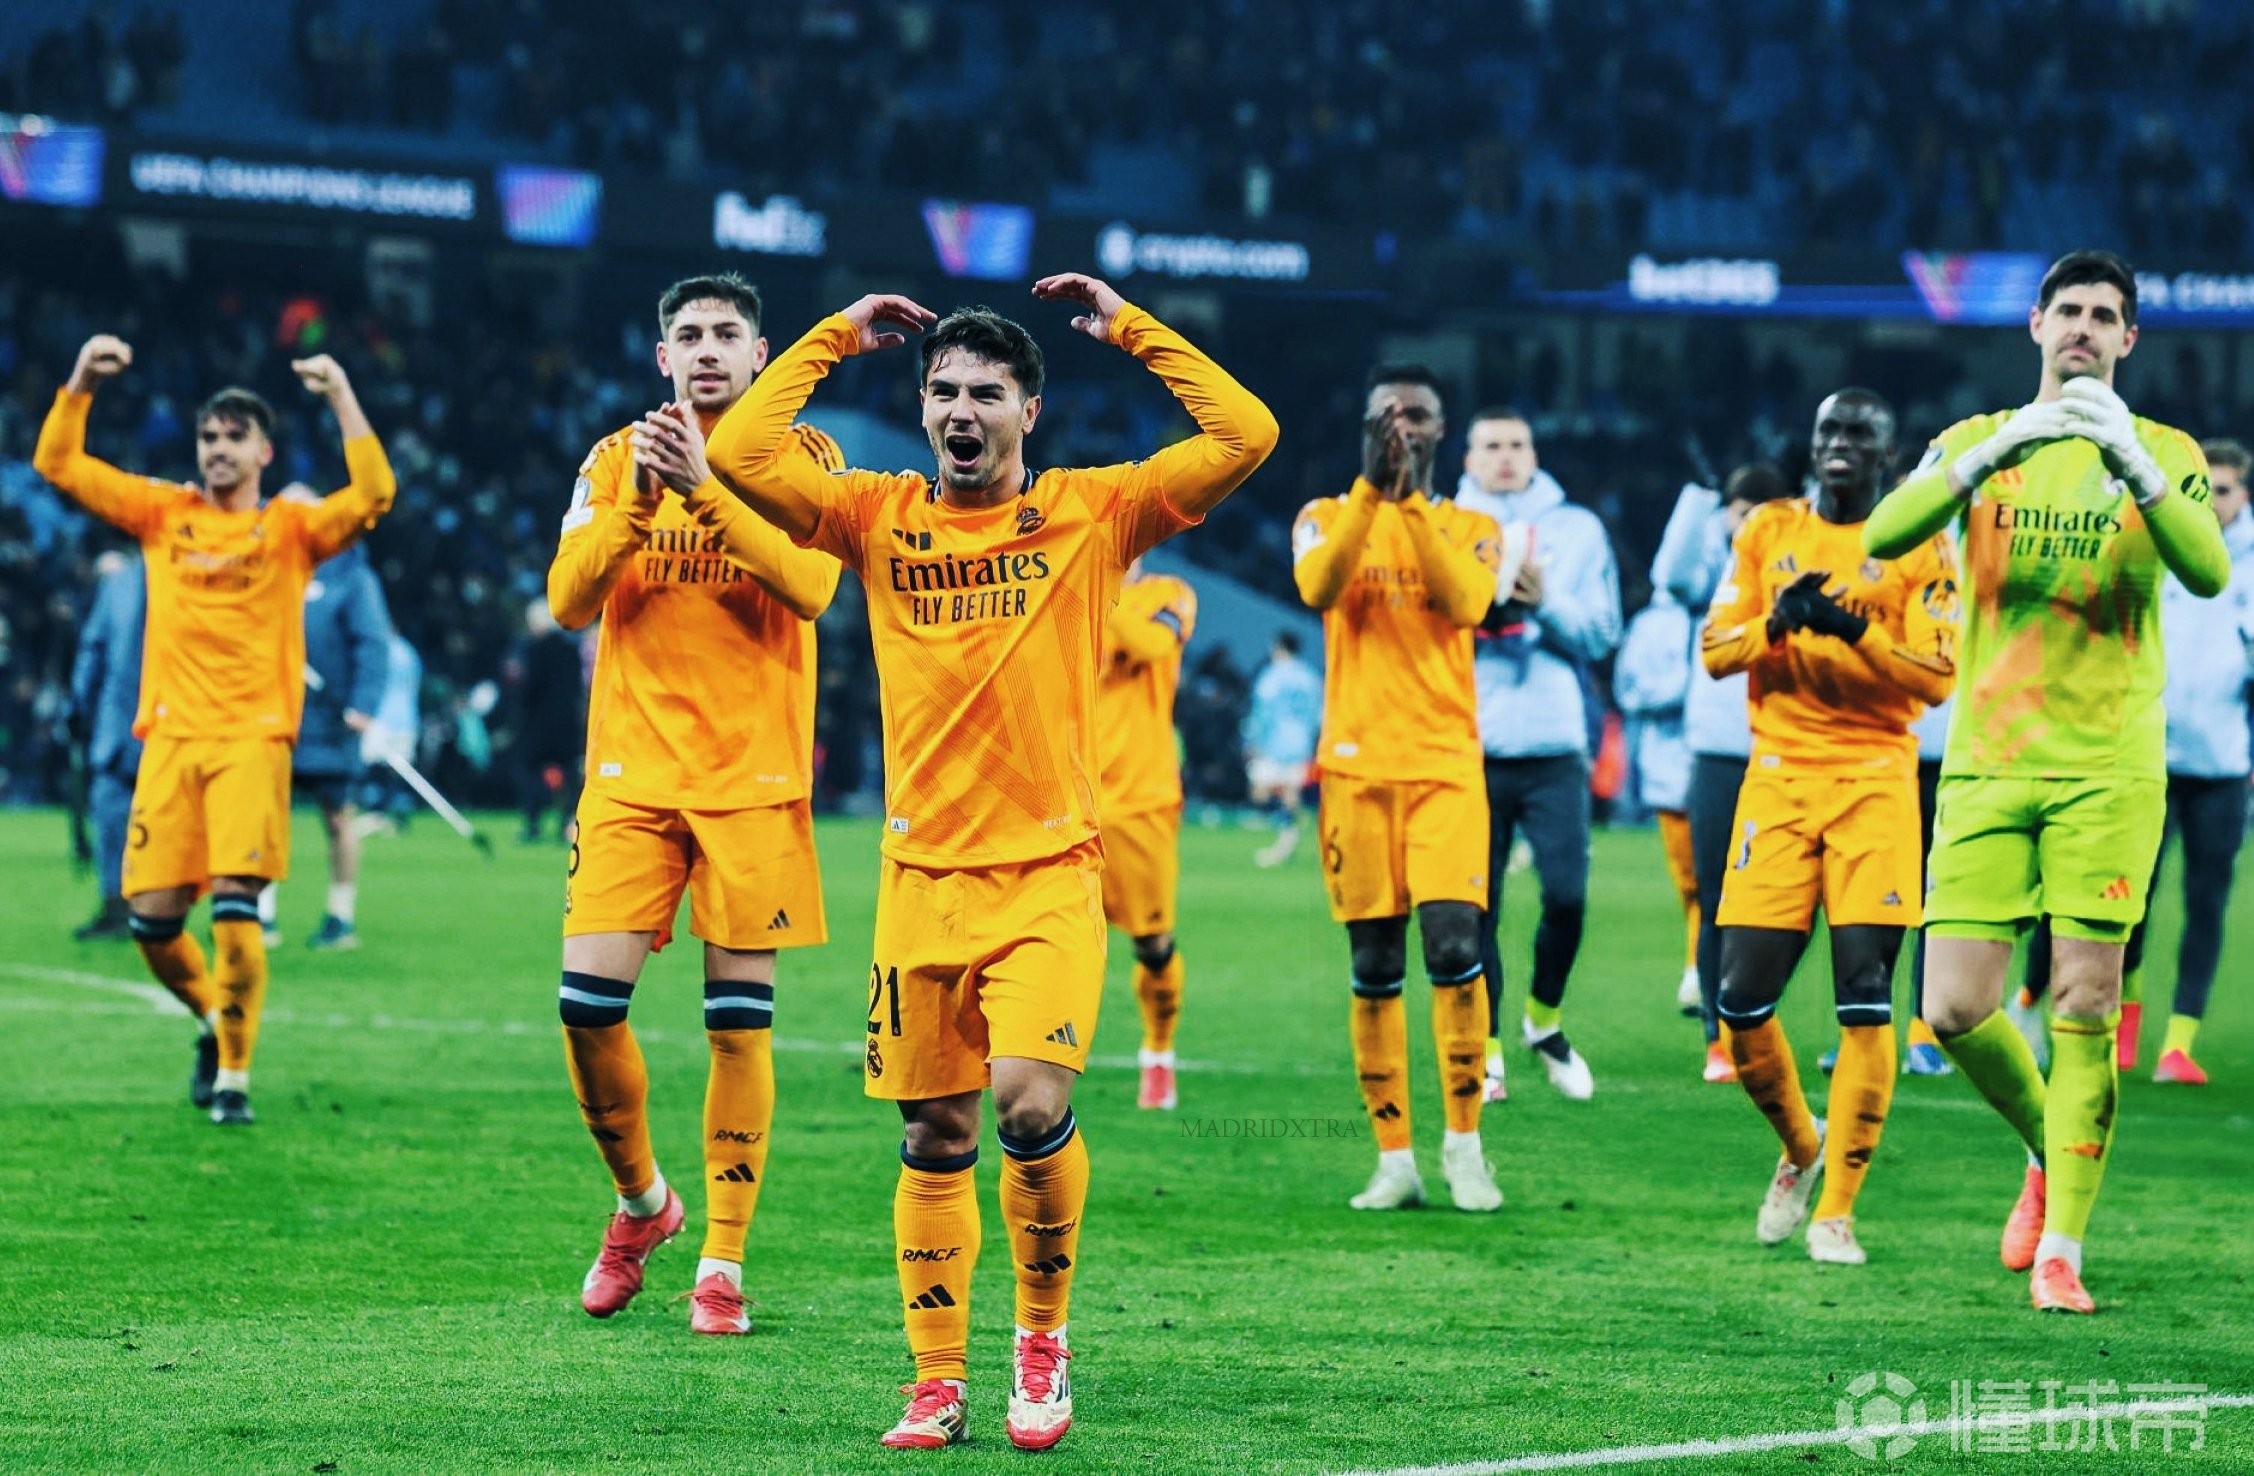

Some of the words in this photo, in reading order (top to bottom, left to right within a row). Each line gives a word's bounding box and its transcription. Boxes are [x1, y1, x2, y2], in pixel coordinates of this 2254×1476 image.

[1994, 504, 2121, 534] Emirates
[2009, 534, 2035, 557] FLY
[2040, 536, 2101, 560] BETTER
[643, 558, 672, 584] FLY
[888, 551, 1050, 592] Emirates
[913, 596, 942, 626] FLY
[951, 588, 1026, 623] BETTER
[867, 962, 902, 1037] 21
[902, 1247, 962, 1262] RMCF
